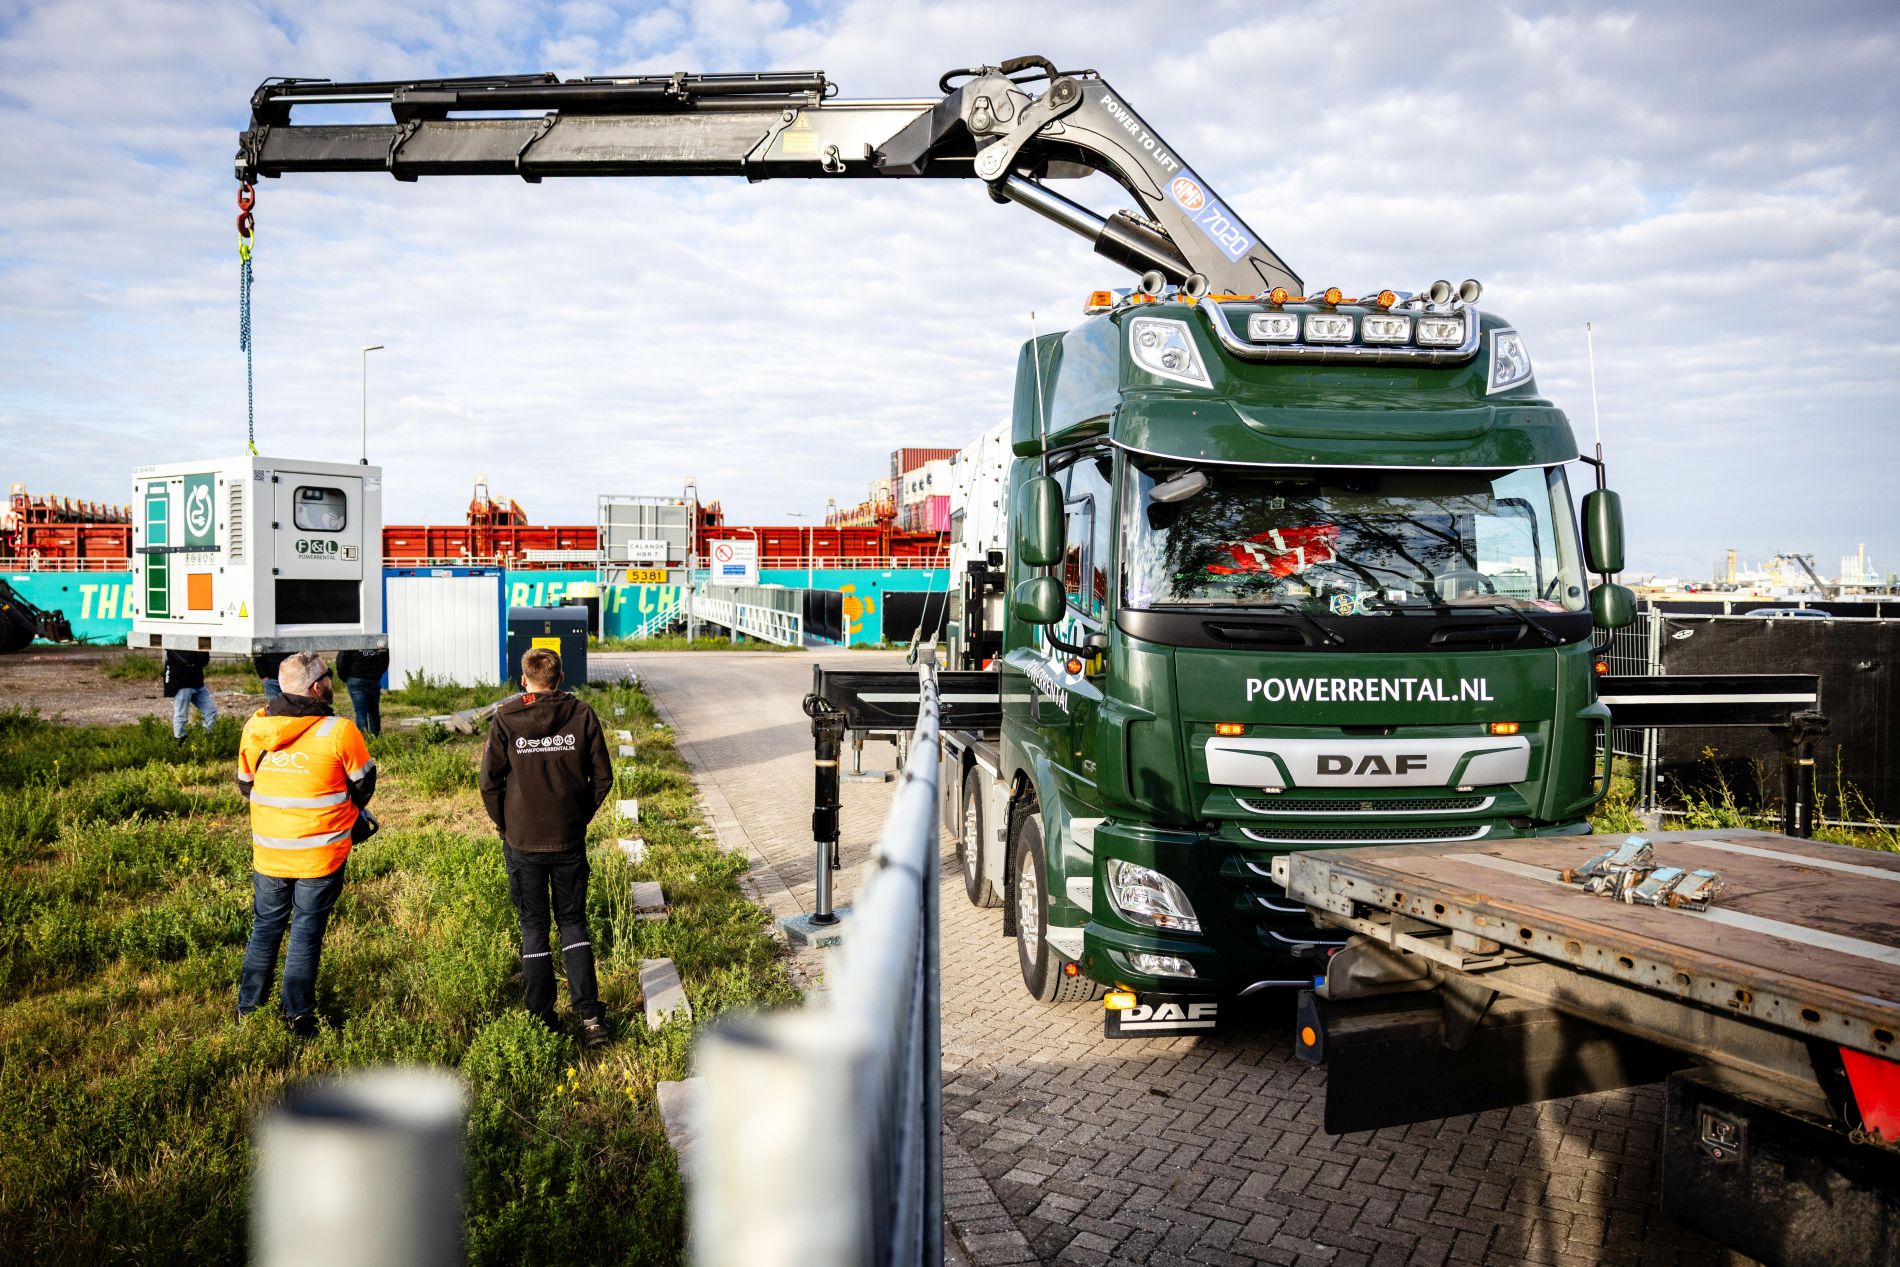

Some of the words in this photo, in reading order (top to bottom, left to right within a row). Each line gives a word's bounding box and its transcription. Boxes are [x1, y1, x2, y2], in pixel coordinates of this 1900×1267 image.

[1100, 94, 1140, 136] POWER
[1138, 131, 1155, 150] TO
[1152, 147, 1179, 172] LIFT
[1174, 179, 1204, 207] HMF
[1202, 207, 1249, 255] 7020
[632, 571, 661, 581] 5381
[79, 584, 133, 619] THE
[1246, 677, 1494, 702] POWERRENTAL.NL
[1316, 754, 1427, 775] DAF
[1120, 1003, 1218, 1022] DAF
